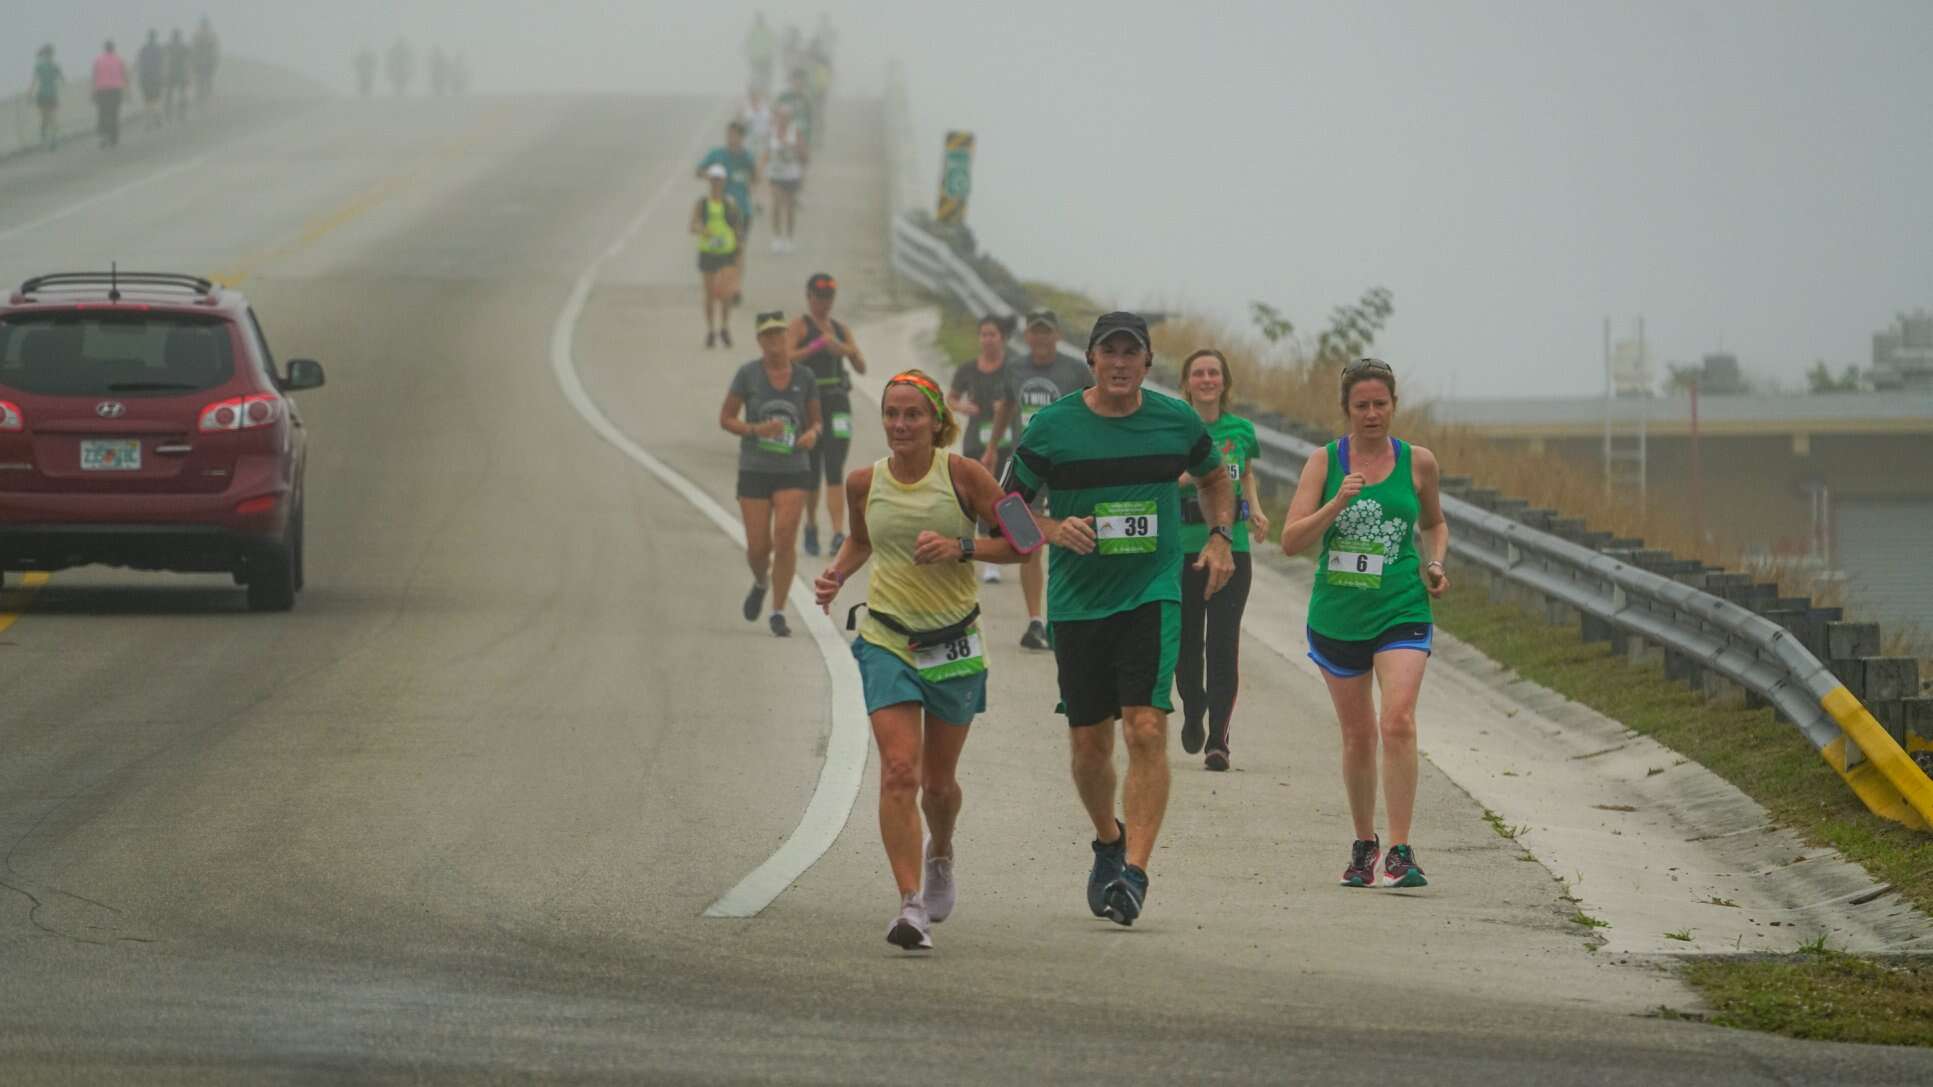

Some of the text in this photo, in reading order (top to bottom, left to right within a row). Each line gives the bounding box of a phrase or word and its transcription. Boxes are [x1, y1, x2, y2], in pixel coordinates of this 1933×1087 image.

[1125, 516, 1148, 536] 39
[1356, 554, 1368, 572] 6
[945, 638, 971, 660] 38
